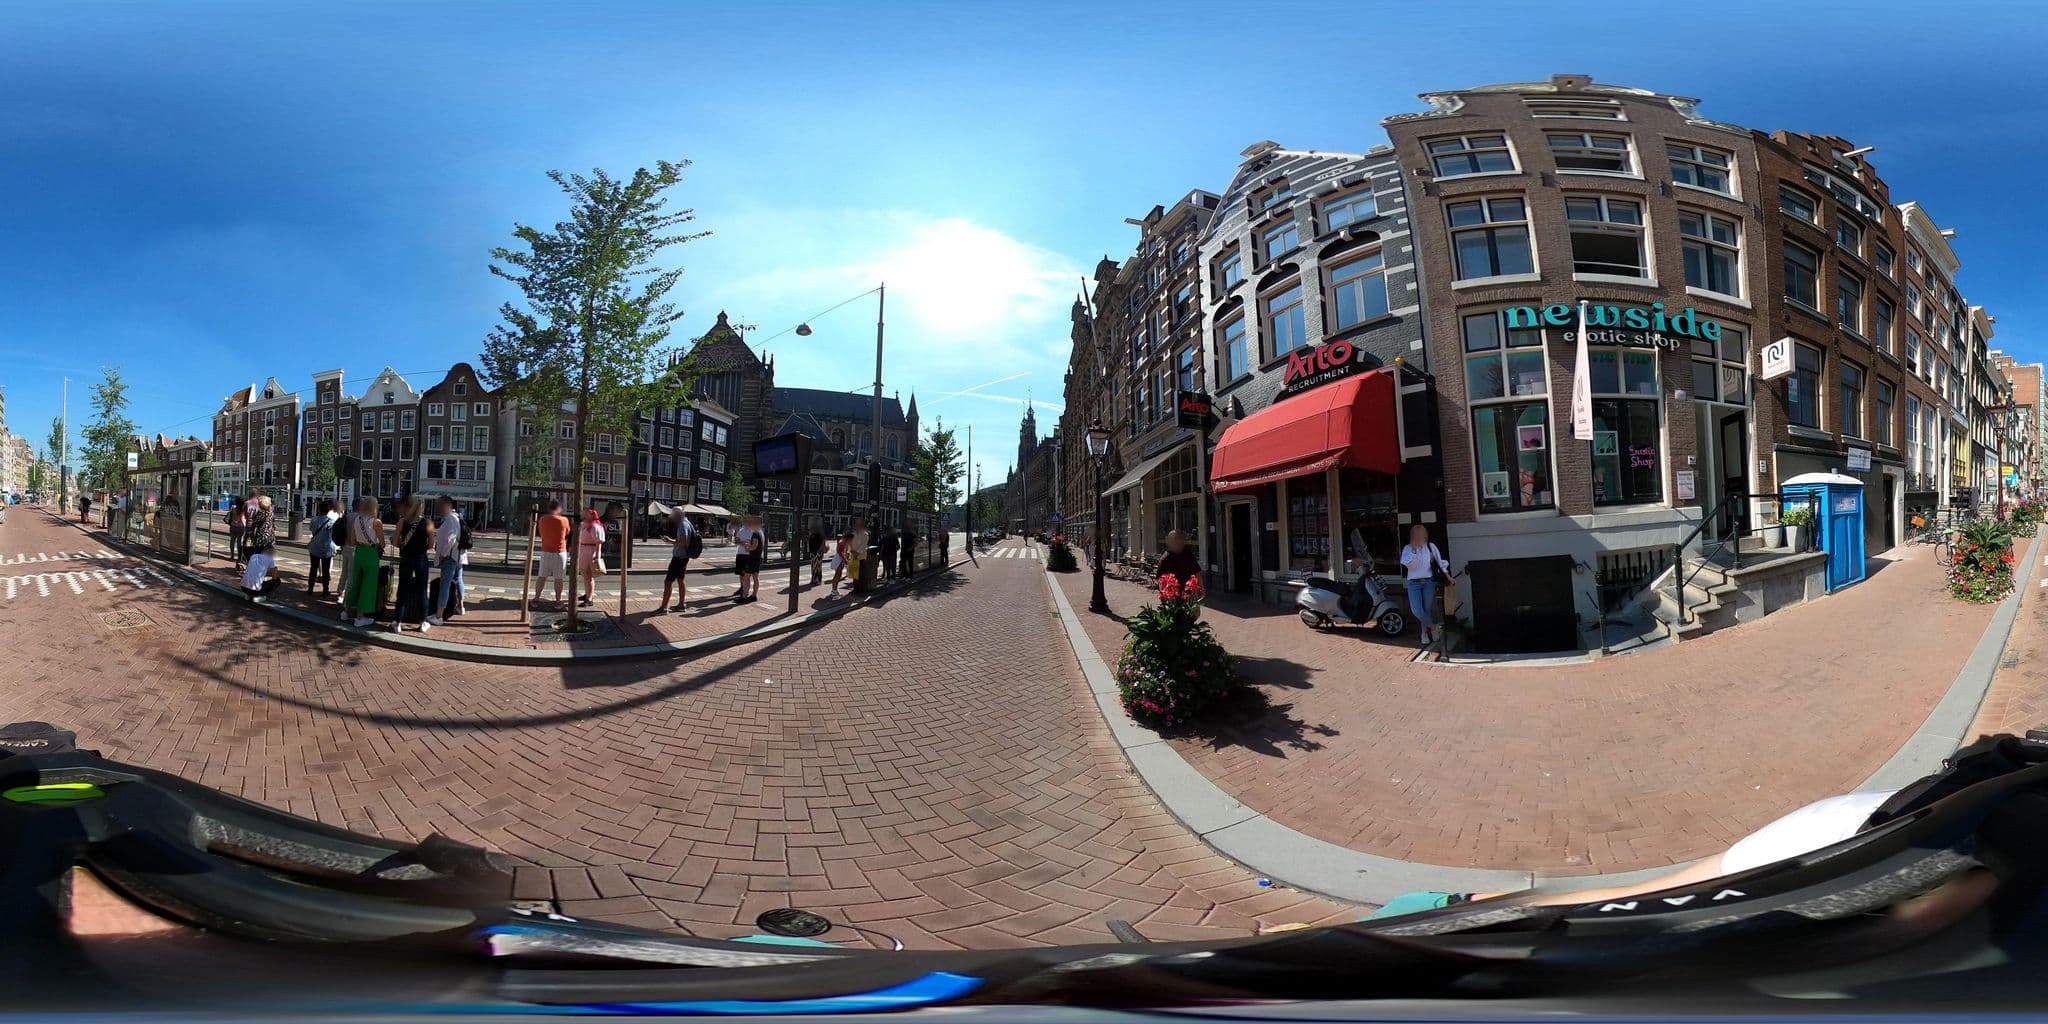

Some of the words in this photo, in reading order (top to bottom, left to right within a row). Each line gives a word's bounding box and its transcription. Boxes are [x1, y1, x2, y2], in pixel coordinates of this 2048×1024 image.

[1505, 302, 1722, 341] newside
[1563, 329, 1626, 345] eotic
[1634, 332, 1681, 350] shop
[1283, 340, 1352, 385] Arto
[1288, 365, 1350, 393] RECRUITMENT
[1180, 398, 1209, 413] Arto
[1630, 456, 1655, 470] Shop
